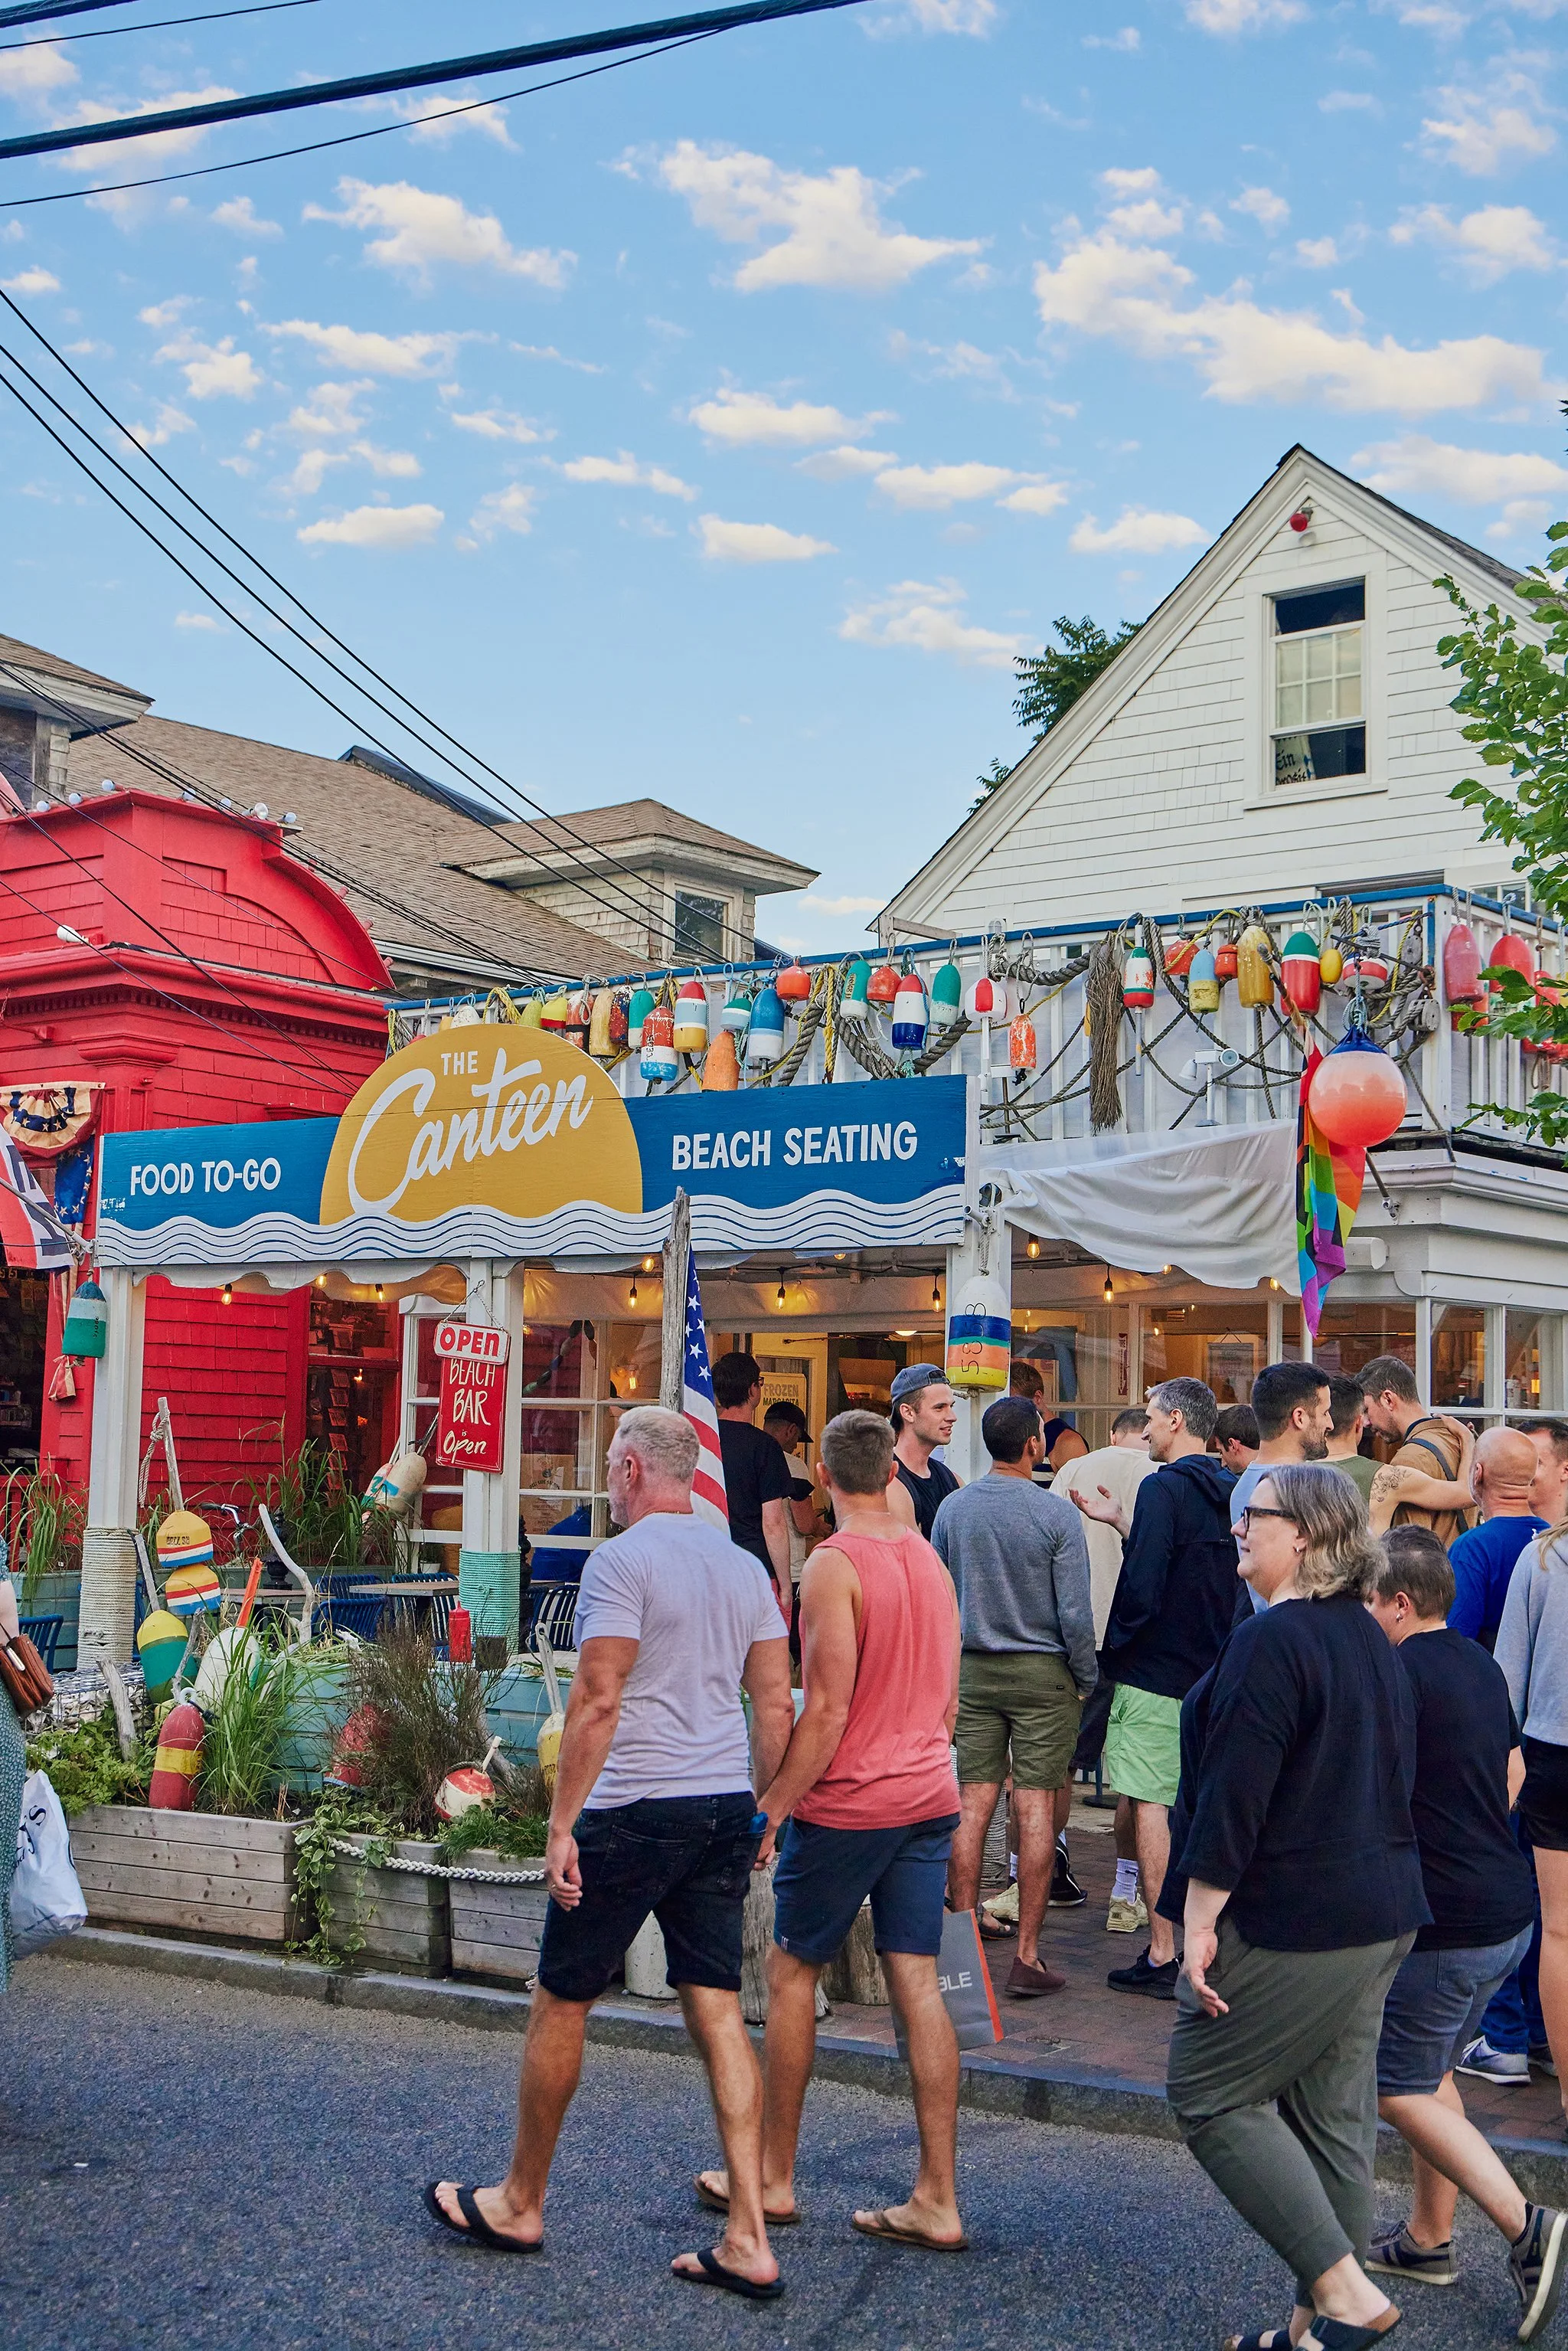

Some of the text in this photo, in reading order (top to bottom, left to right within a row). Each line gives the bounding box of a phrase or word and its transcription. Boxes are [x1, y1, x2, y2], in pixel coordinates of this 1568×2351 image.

[441, 1051, 478, 1075] THE
[348, 1048, 594, 1214] Canteen
[672, 1121, 917, 1170] BEACH SEATING
[130, 1157, 281, 1196] FOOD TO-GO
[439, 1326, 500, 1357] OPEN
[449, 1359, 496, 1388] BEACH
[763, 1383, 799, 1398] FROZEN
[452, 1388, 491, 1426] BAR
[443, 1430, 487, 1464] Open
